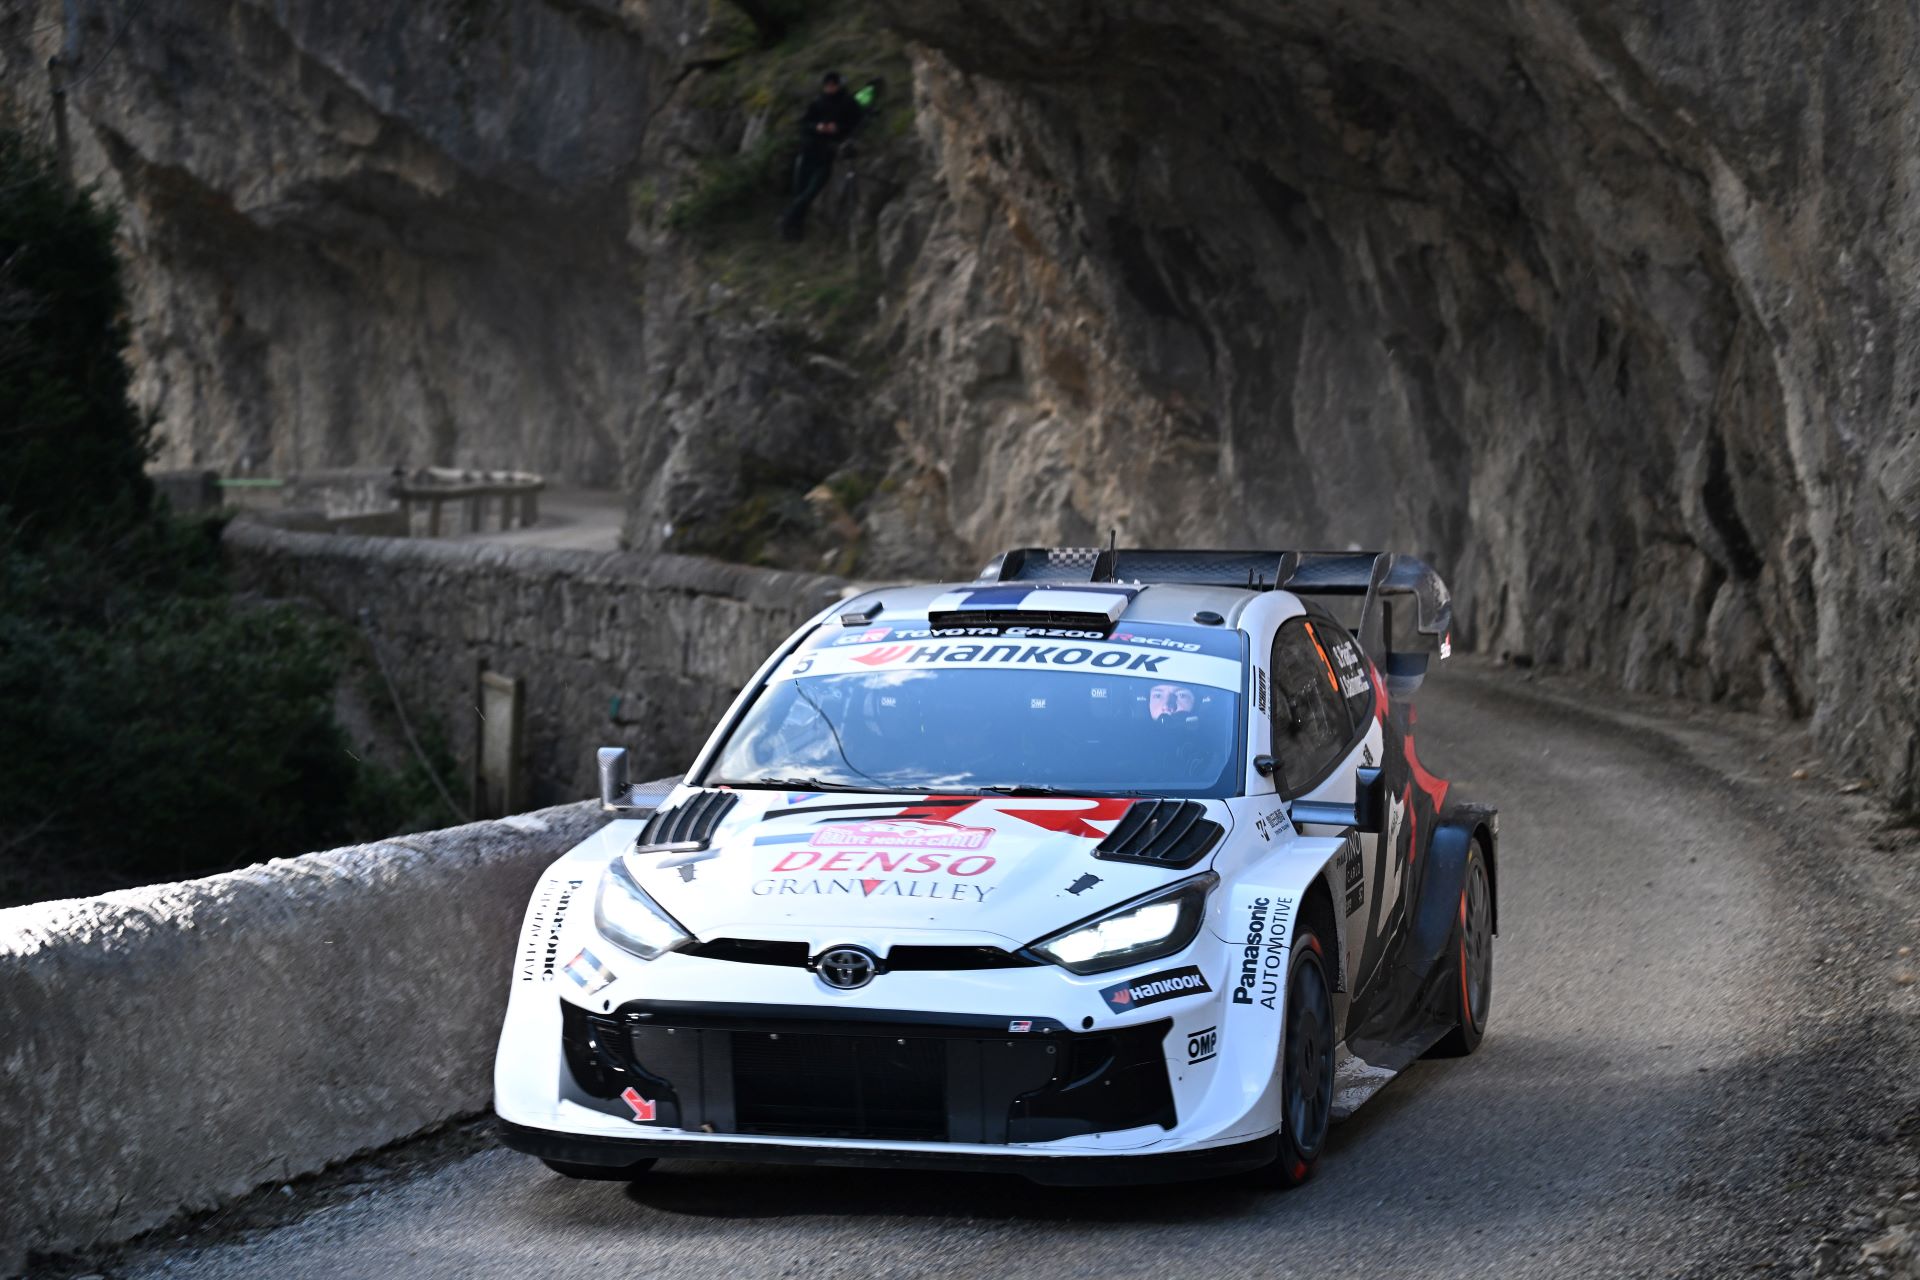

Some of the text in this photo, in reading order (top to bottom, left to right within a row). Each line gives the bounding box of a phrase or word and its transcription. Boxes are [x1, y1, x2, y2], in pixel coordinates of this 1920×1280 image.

[894, 627, 999, 639] TOYOTA
[1005, 626, 1104, 639] GAZOO
[1109, 633, 1201, 652] Racing
[792, 652, 818, 675] 5
[816, 827, 869, 845] RALLYE
[771, 851, 997, 877] DENSO
[1232, 897, 1270, 1005] Panasonic
[1260, 897, 1293, 1010] AUTOMOTIVE
[1188, 1031, 1217, 1059] OMP
